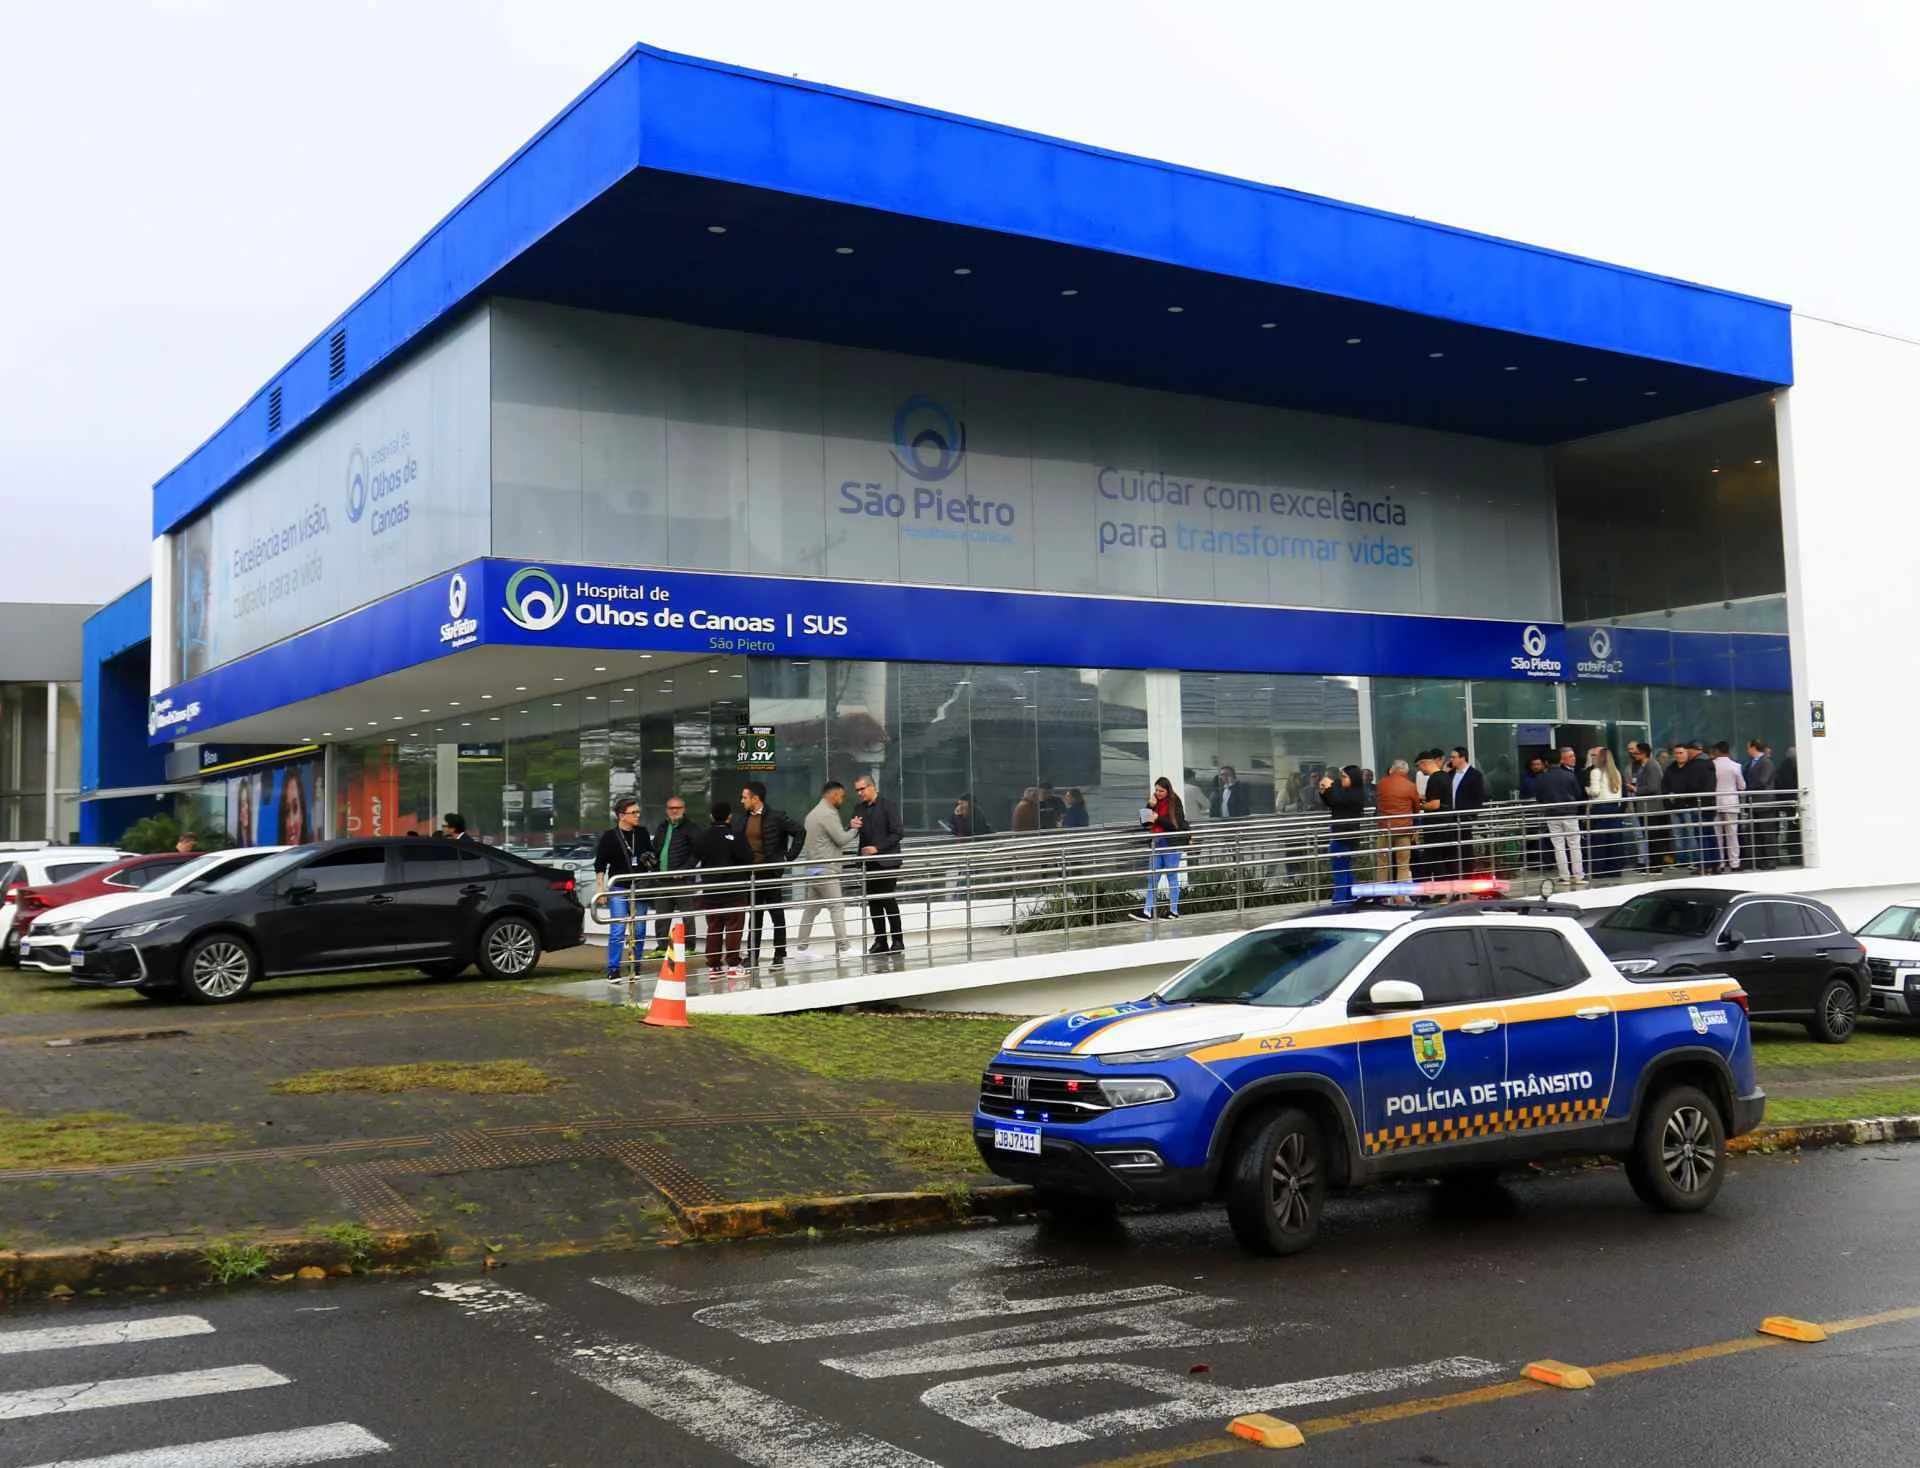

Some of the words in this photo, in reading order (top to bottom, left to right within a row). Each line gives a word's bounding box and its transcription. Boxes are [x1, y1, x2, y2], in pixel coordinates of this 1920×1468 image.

[371, 468, 401, 501] Olhos
[403, 455, 417, 484] de
[1097, 465, 1195, 505] Cuidar
[1203, 485, 1261, 513] com
[1269, 489, 1406, 526] excelência
[371, 500, 409, 536] Canoas
[839, 480, 905, 518] São
[913, 487, 1015, 526] Pietro
[233, 528, 280, 578] Excelência
[281, 523, 298, 551] em
[299, 502, 330, 543] visão,
[1099, 519, 1166, 553] para
[1175, 521, 1339, 562] transformar
[1346, 534, 1415, 567] vidas
[576, 581, 644, 602] Hospital
[649, 582, 670, 602] de
[575, 603, 648, 628] Olhos
[654, 606, 683, 628] de
[689, 609, 776, 633] Canoas
[803, 613, 848, 636] SUS
[709, 636, 734, 651] São
[737, 638, 776, 652] Pietro
[1511, 657, 1531, 670] São
[1531, 658, 1562, 671] Pietro
[750, 751, 775, 761] STV
[1260, 1035, 1297, 1050] 422
[1386, 1085, 1467, 1117] POLÍCIA
[1470, 1083, 1499, 1105] DE
[1501, 1071, 1594, 1100] TRÂNSITO
